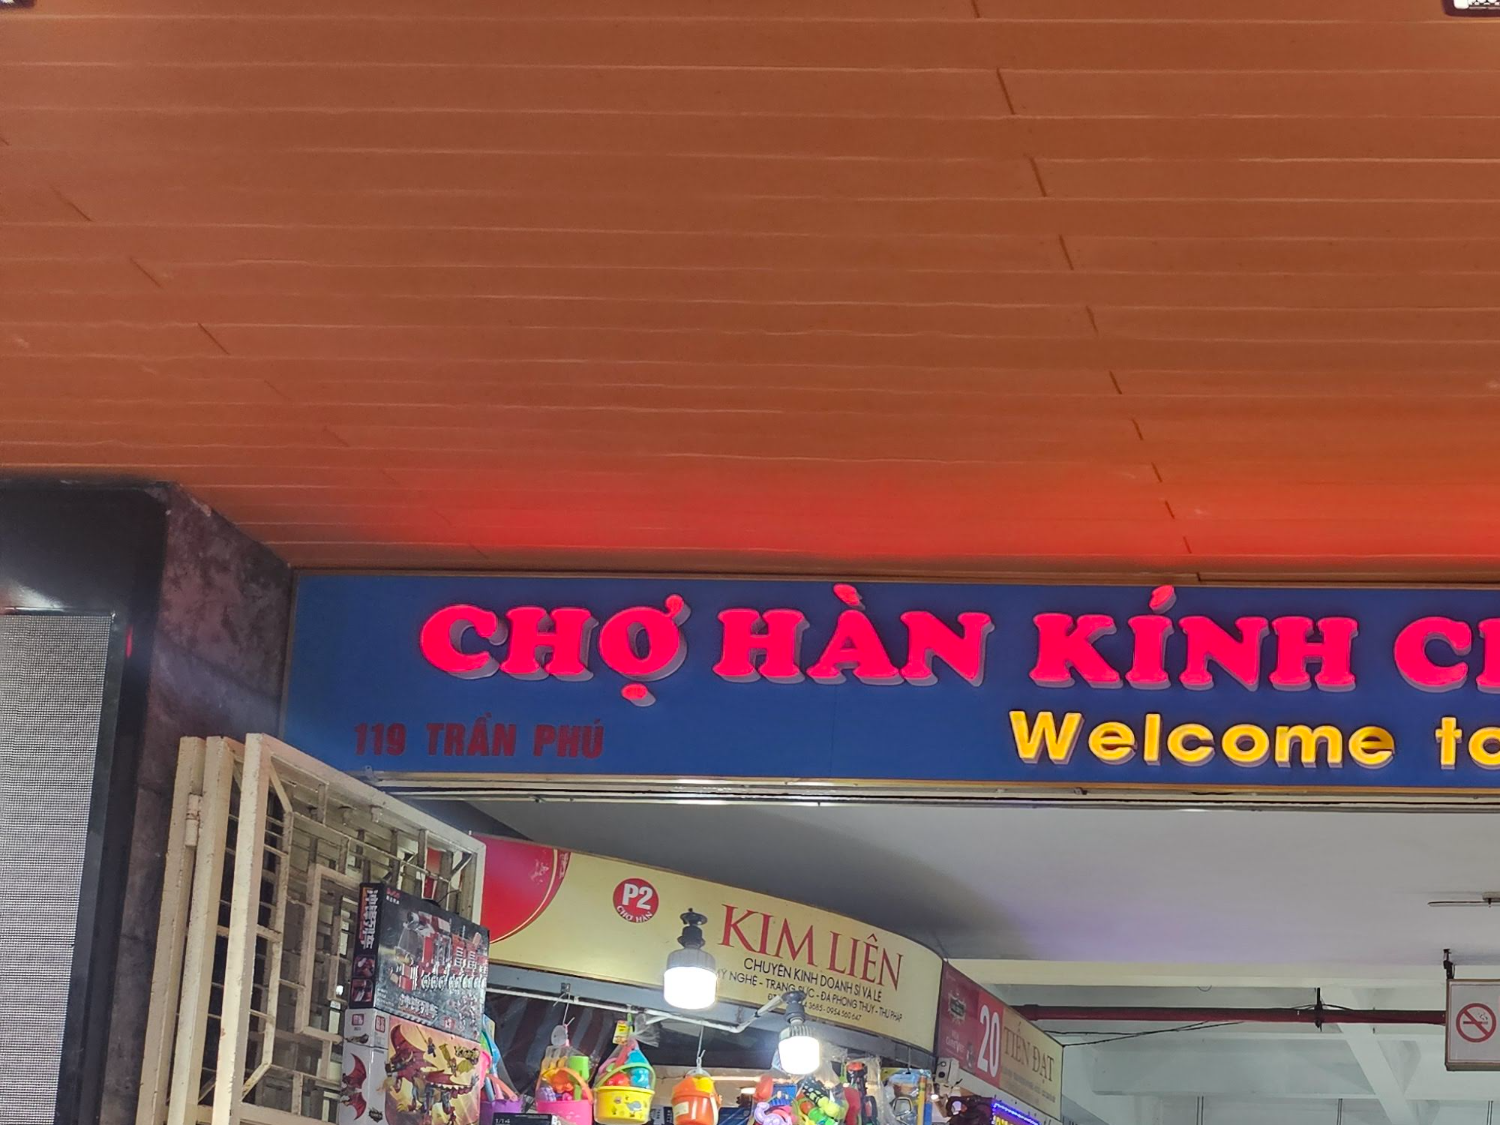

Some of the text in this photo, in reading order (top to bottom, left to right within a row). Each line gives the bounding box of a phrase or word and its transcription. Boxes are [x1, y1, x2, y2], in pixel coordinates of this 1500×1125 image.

[420, 594, 692, 707] CHỢ
[712, 583, 995, 687] HÀN
[1030, 584, 1358, 690] KÍNH
[354, 712, 605, 759] 119 TRẦN PHÚ
[1009, 710, 1395, 767] Welcome
[622, 883, 653, 910] P2
[718, 904, 904, 991] KIM LIÊN
[743, 957, 792, 978] CHUYÊN
[793, 968, 819, 985] KINH
[820, 975, 853, 994] DOANH
[765, 978, 796, 993] TRANG
[831, 994, 858, 1010] PHONG
[977, 1004, 1000, 1077] 20
